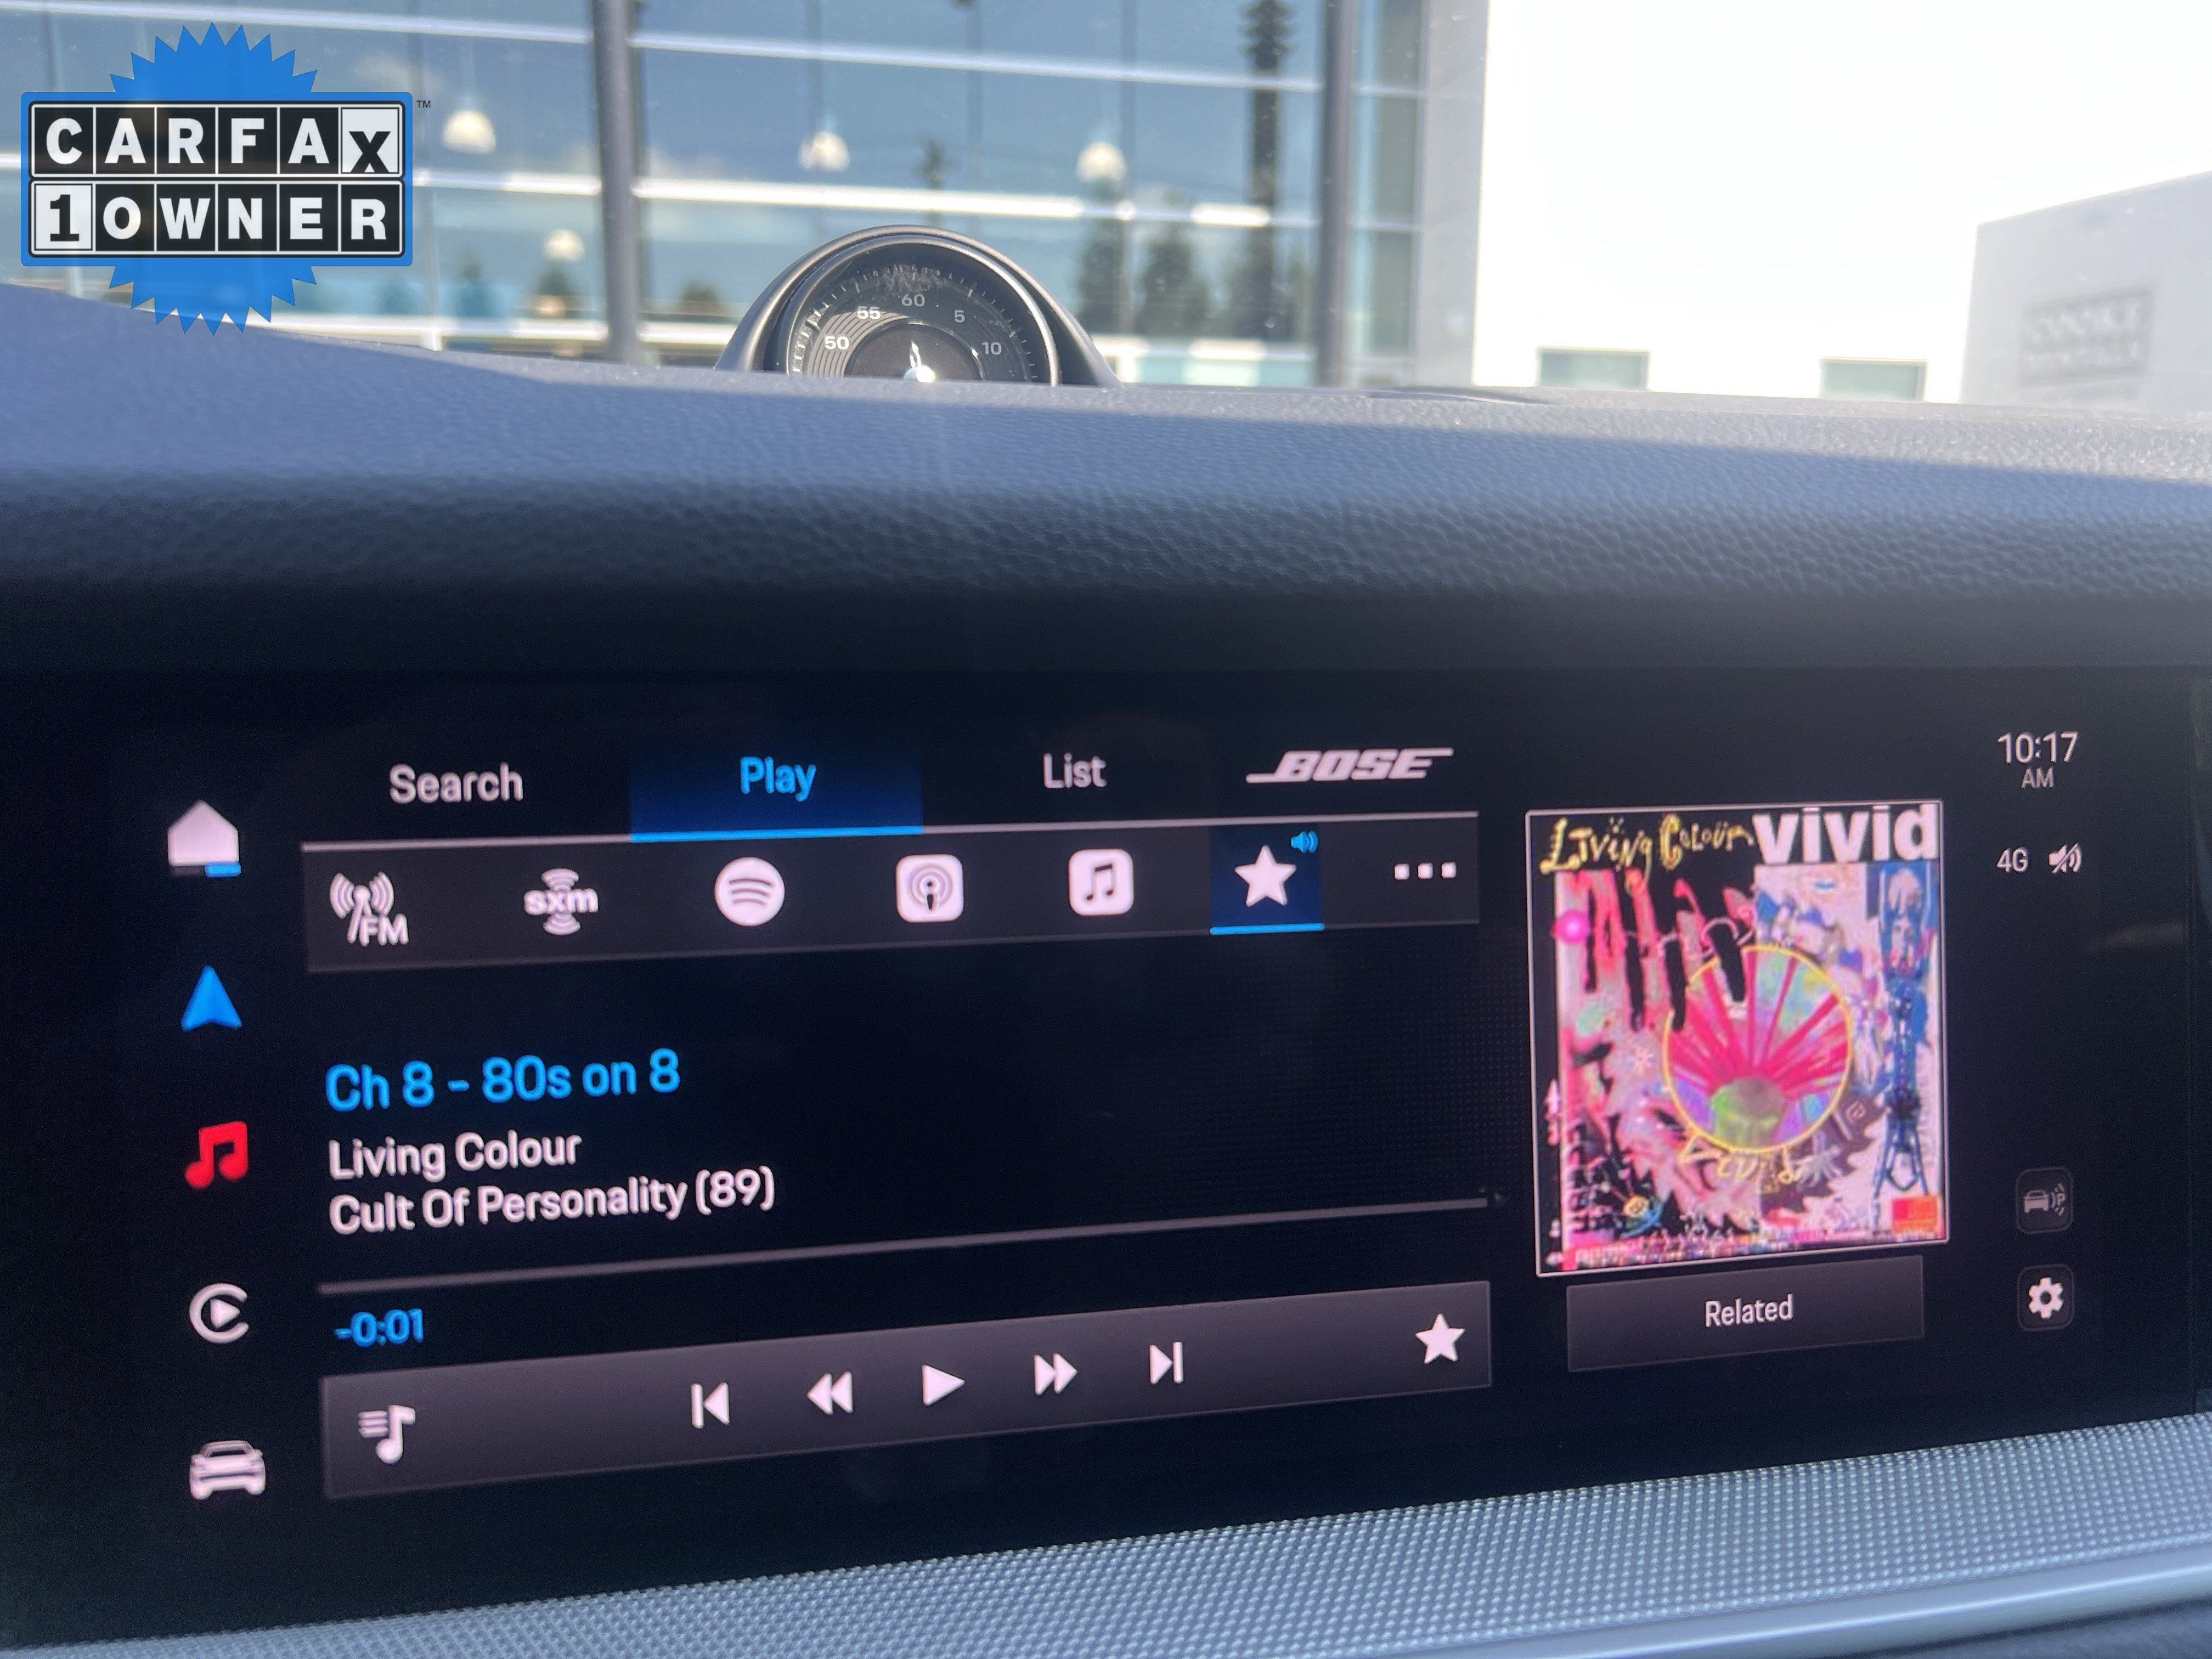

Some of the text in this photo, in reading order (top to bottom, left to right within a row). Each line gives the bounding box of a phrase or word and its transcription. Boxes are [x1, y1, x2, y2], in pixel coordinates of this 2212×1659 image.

[857, 306, 881, 319] 55
[901, 294, 926, 307] 60
[955, 310, 965, 323] 5
[825, 336, 849, 349] 50
[982, 342, 1002, 355] 10
[1997, 731, 2078, 763] 10:17
[740, 757, 817, 802] Play
[1043, 753, 1107, 788] List
[1246, 748, 1454, 783] BOSE
[2021, 767, 2054, 788] AM
[390, 763, 523, 803] Search
[1753, 804, 1938, 865] vivid
[1997, 847, 2028, 872] 4G
[524, 888, 599, 916] sxm
[359, 913, 409, 946] FM
[325, 1064, 391, 1111] Ch
[402, 1060, 435, 1107] 8
[483, 1054, 572, 1103] 80s
[582, 1061, 637, 1097] on
[650, 1048, 680, 1093] 8
[329, 1130, 583, 1182] Living Colour
[330, 1165, 775, 1235] Cult Of Personality (89)
[1705, 1293, 1793, 1328] Related
[335, 1308, 425, 1348] -0:01
